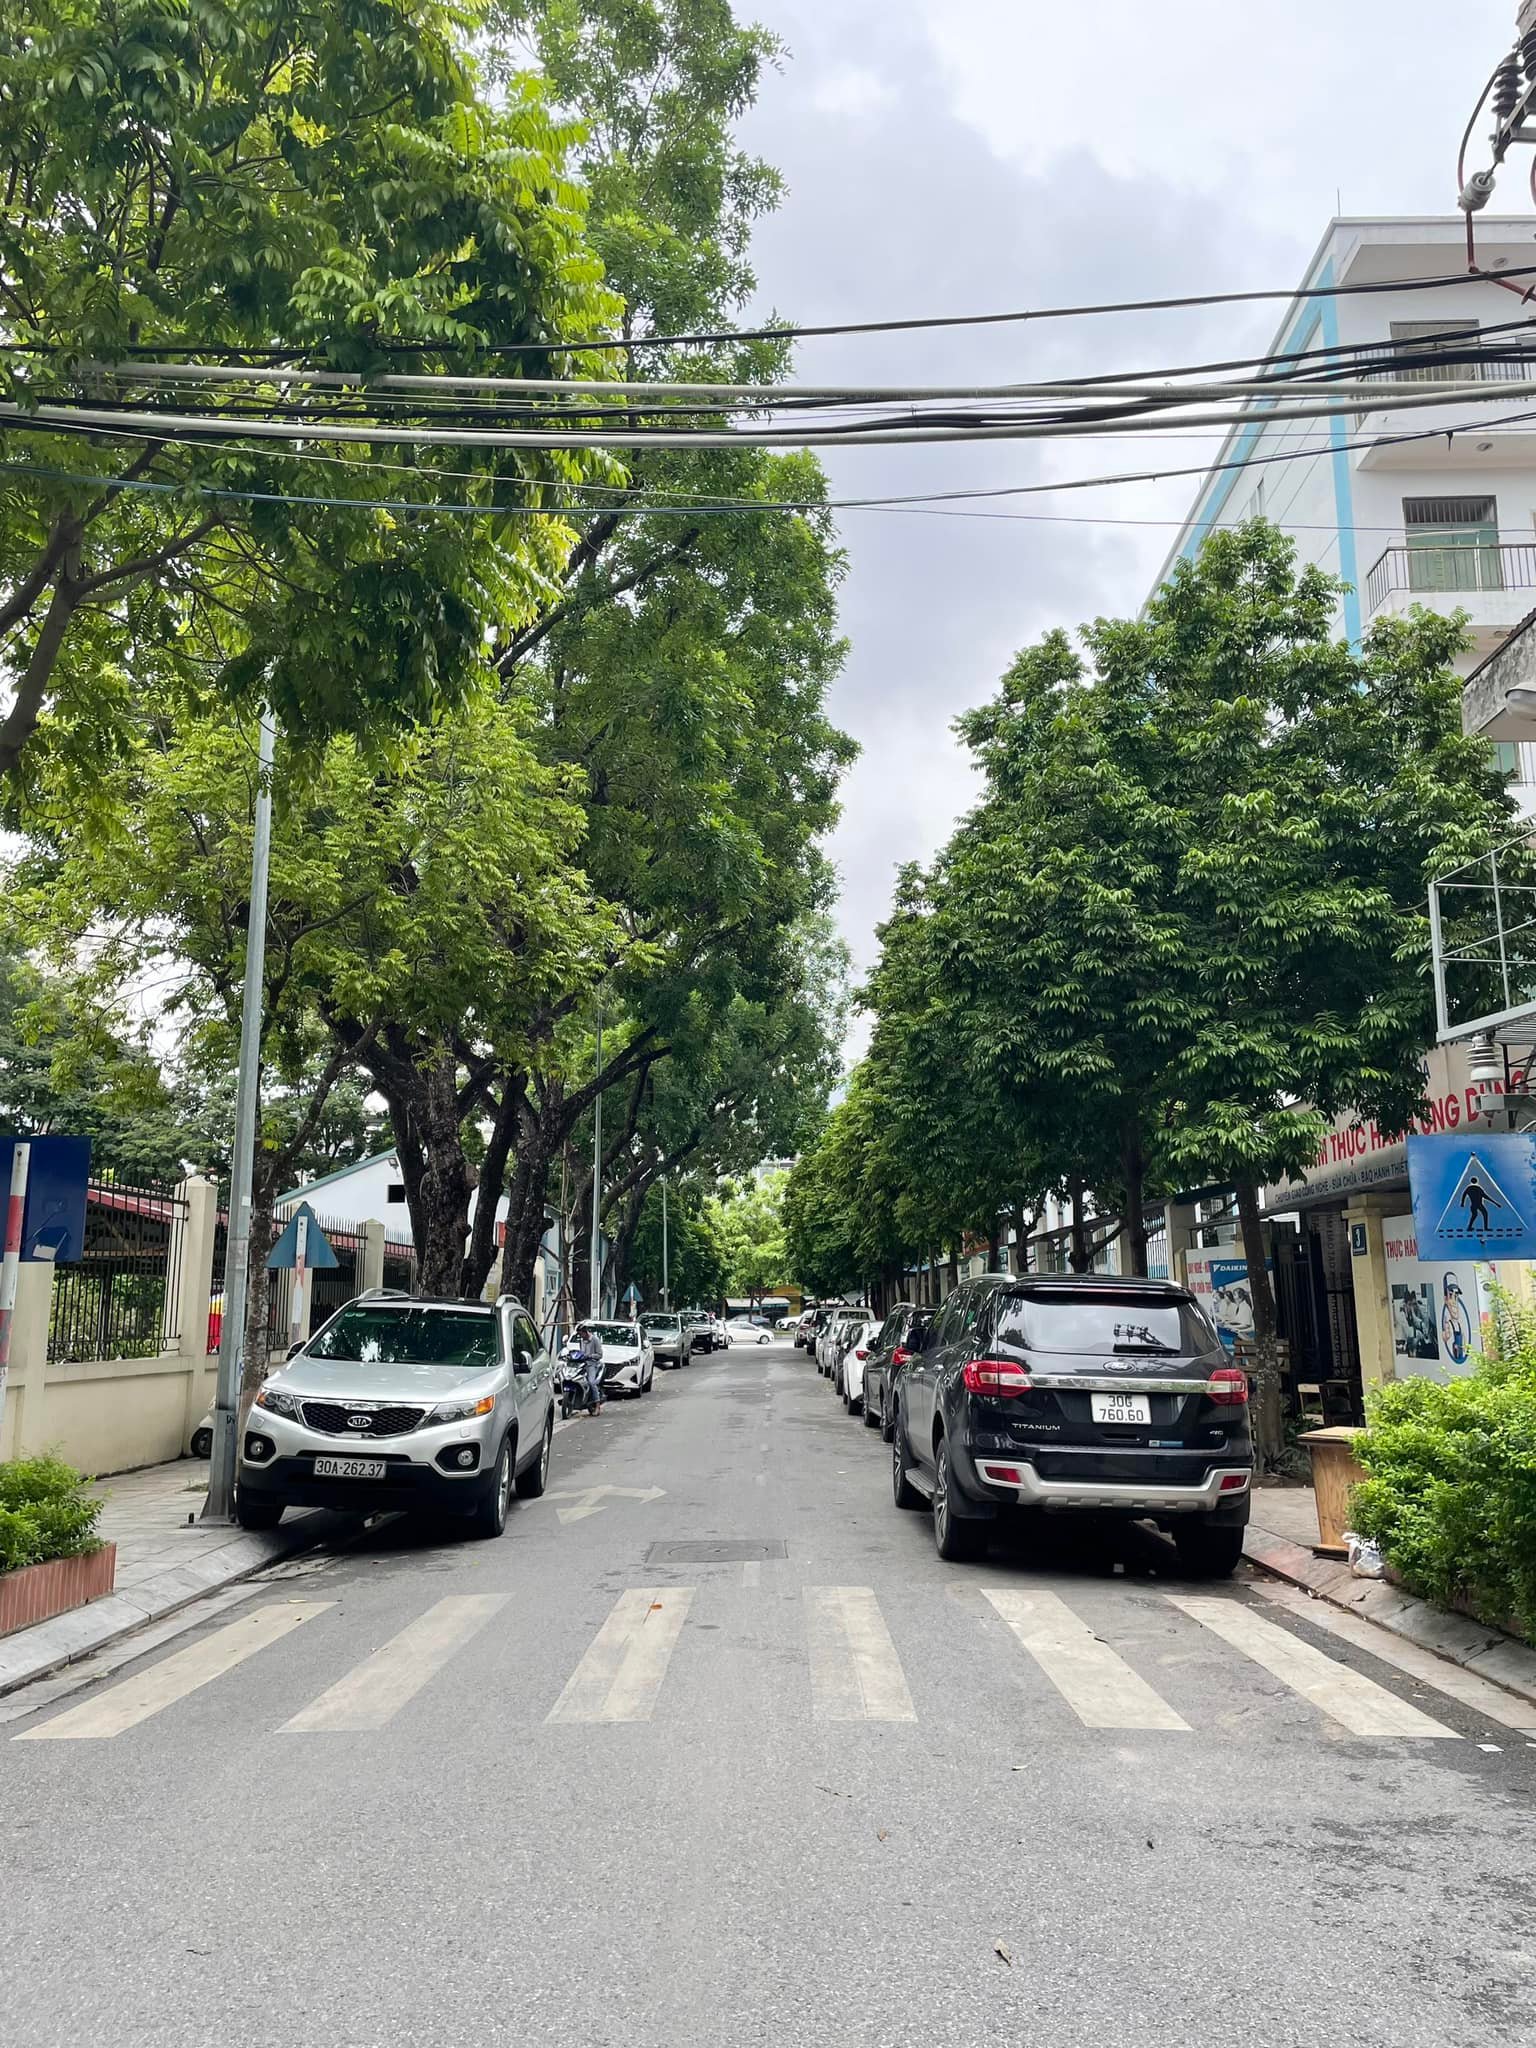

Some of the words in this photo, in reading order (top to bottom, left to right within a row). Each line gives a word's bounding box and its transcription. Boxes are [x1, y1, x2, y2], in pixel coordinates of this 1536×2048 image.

[1355, 1228, 1361, 1248] 3
[1220, 1264, 1248, 1272] DAIKIN
[1108, 1395, 1132, 1408] 30G
[1099, 1408, 1144, 1421] 760.60
[1011, 1423, 1061, 1431] TITANIUM
[316, 1460, 384, 1478] 30A-262.37
